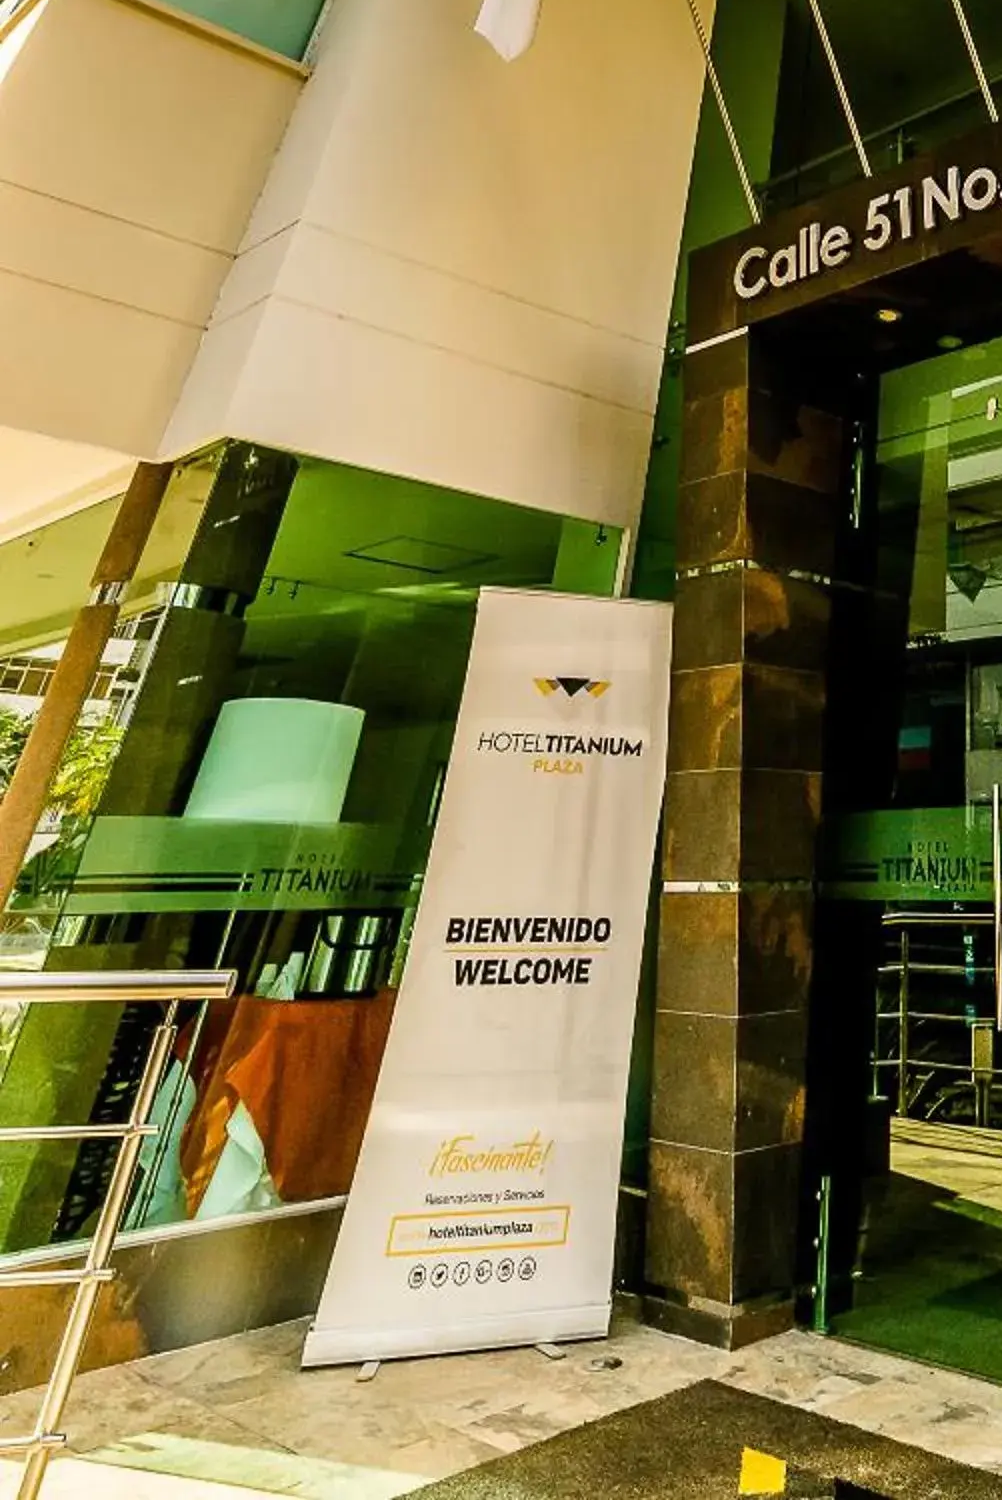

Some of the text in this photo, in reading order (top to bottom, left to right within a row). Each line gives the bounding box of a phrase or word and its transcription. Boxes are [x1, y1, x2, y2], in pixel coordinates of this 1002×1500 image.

[733, 222, 852, 298] Calle
[863, 186, 914, 252] 51
[533, 759, 584, 774] PLAZA
[260, 868, 373, 892] TITANIUM
[881, 858, 978, 883] TITANIUM
[445, 917, 611, 944] BIENVENIDO
[454, 958, 593, 986] WELCOME
